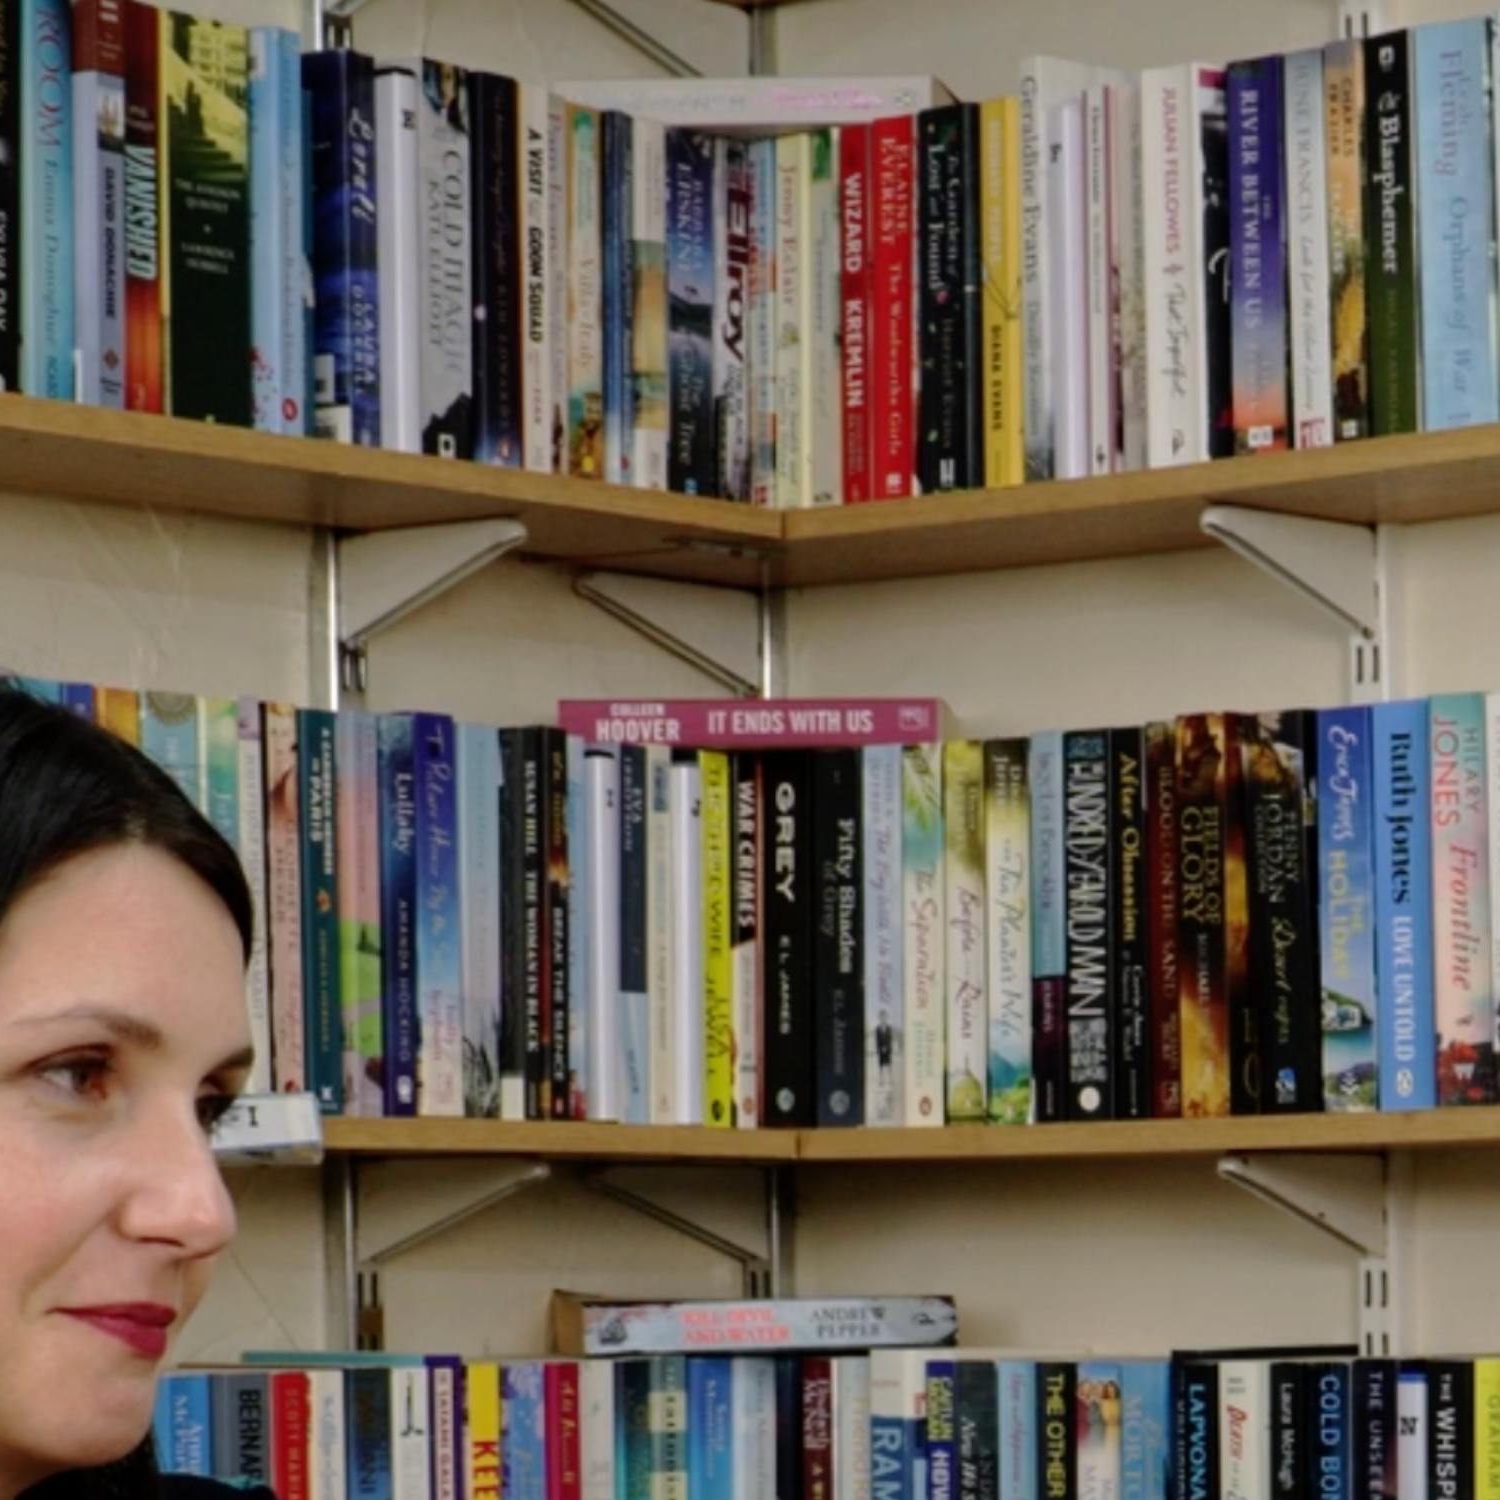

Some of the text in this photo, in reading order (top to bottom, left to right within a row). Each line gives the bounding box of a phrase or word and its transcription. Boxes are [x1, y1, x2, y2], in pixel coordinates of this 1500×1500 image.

[124, 145, 158, 283] VANISHED
[527, 127, 544, 197] A VISIT
[1162, 86, 1183, 255] JULIAN FELLOWES
[1238, 88, 1262, 330] RIVER BETWEEN US
[1373, 116, 1404, 276] Blasphemer
[527, 226, 545, 344] GOON SQUAD
[722, 180, 751, 363] Ellroy
[844, 171, 866, 408] WIZARD KREMLIN
[595, 717, 681, 744] HOOVER
[707, 707, 874, 735] IT ENDS WITH US
[1432, 714, 1462, 828] JONES
[1461, 727, 1481, 816] HILARY
[390, 771, 414, 858] Lullaby
[736, 779, 757, 929] WAR CRIMES
[775, 780, 797, 904] GREY
[1119, 752, 1141, 942] After Obsession
[1180, 805, 1204, 926] GLORY
[1262, 793, 1288, 904] JORDAN
[1384, 731, 1418, 906] Ruth Jones
[1326, 849, 1352, 981] HOLIDAY
[1447, 841, 1483, 992] Frontline
[1393, 914, 1416, 1062] LOVE UNTOLD
[1046, 1373, 1065, 1414] THE
[1318, 1373, 1342, 1446] COLD
[1368, 1370, 1385, 1411] THE
[1439, 1372, 1452, 1402] THE
[1046, 1419, 1067, 1497] OTHER
